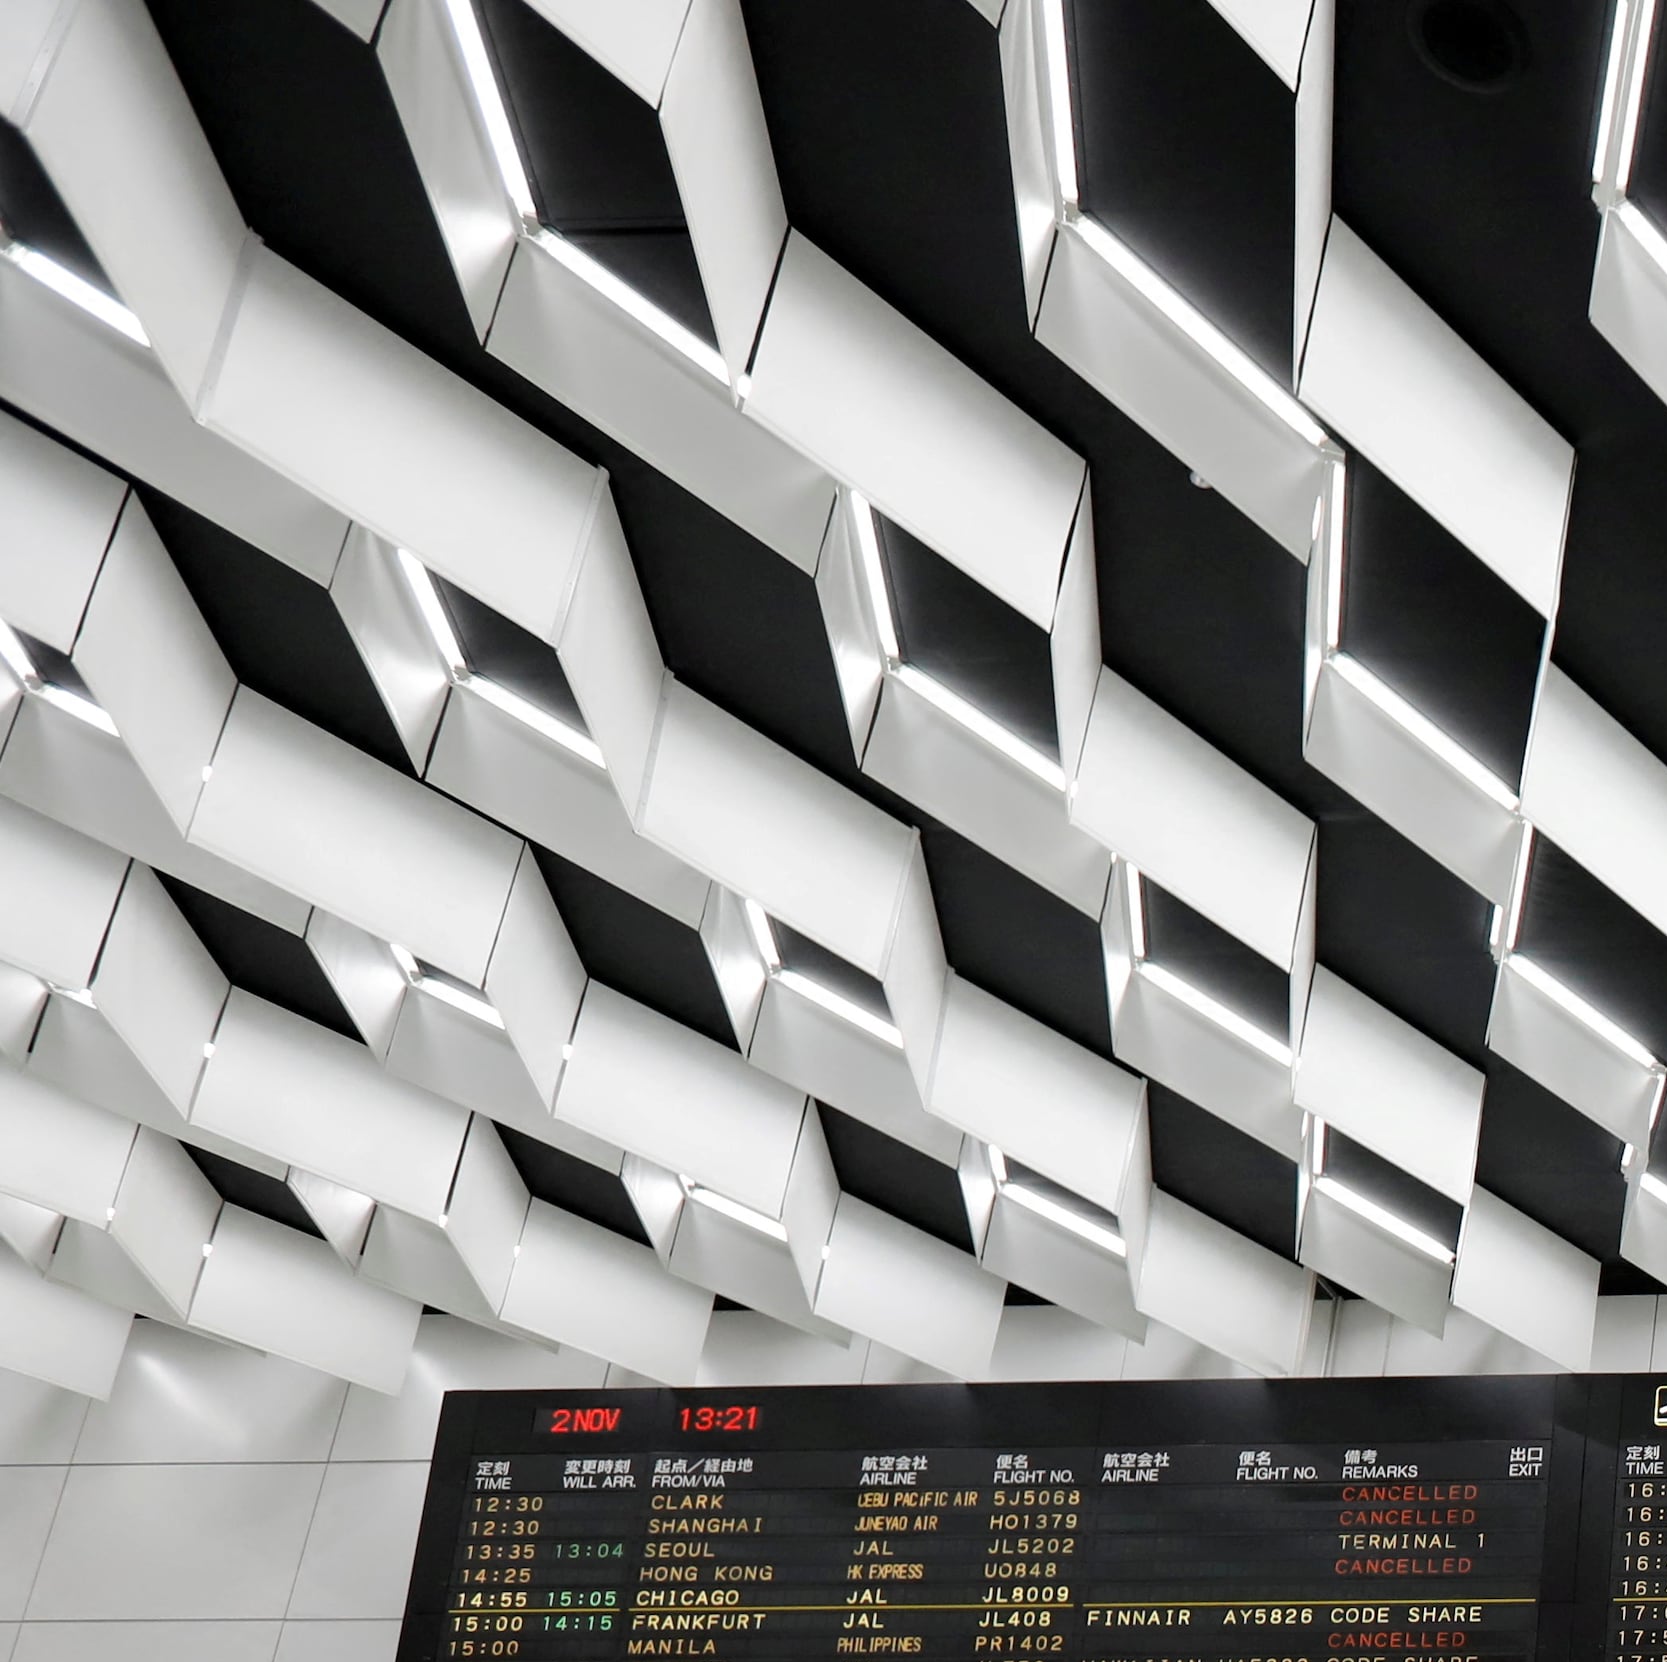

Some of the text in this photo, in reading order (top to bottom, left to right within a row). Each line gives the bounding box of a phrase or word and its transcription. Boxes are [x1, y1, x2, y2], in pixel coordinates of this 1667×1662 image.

[682, 1407, 757, 1430] 13:21
[477, 1461, 510, 1475] 定刻
[565, 1459, 630, 1474] 変更時刻
[862, 1456, 927, 1471] 航空会社
[997, 1455, 1028, 1469] 便名
[1103, 1452, 1169, 1467] 航空会社
[1239, 1451, 1270, 1466] 便名
[1345, 1450, 1377, 1464] 備考
[1510, 1447, 1543, 1462] 出口
[475, 1463, 1542, 1489] TIME WILL ARR. FROM/VIA AIRLINE FLIGHT NO. AIRLINE FLIGHT NO. REMARKS EXIT
[468, 1534, 1485, 1559] 13:35 13:04 SEOUL JAL JL5202 TERMINAL 1
[460, 1587, 1068, 1607] 14:55 15:05 CHICAGO JAL JL8009
[455, 1607, 1481, 1632] 15:00 14:15 FRANKFURT JAL JL408 FINNAIR AY5826 CODE SHARE
